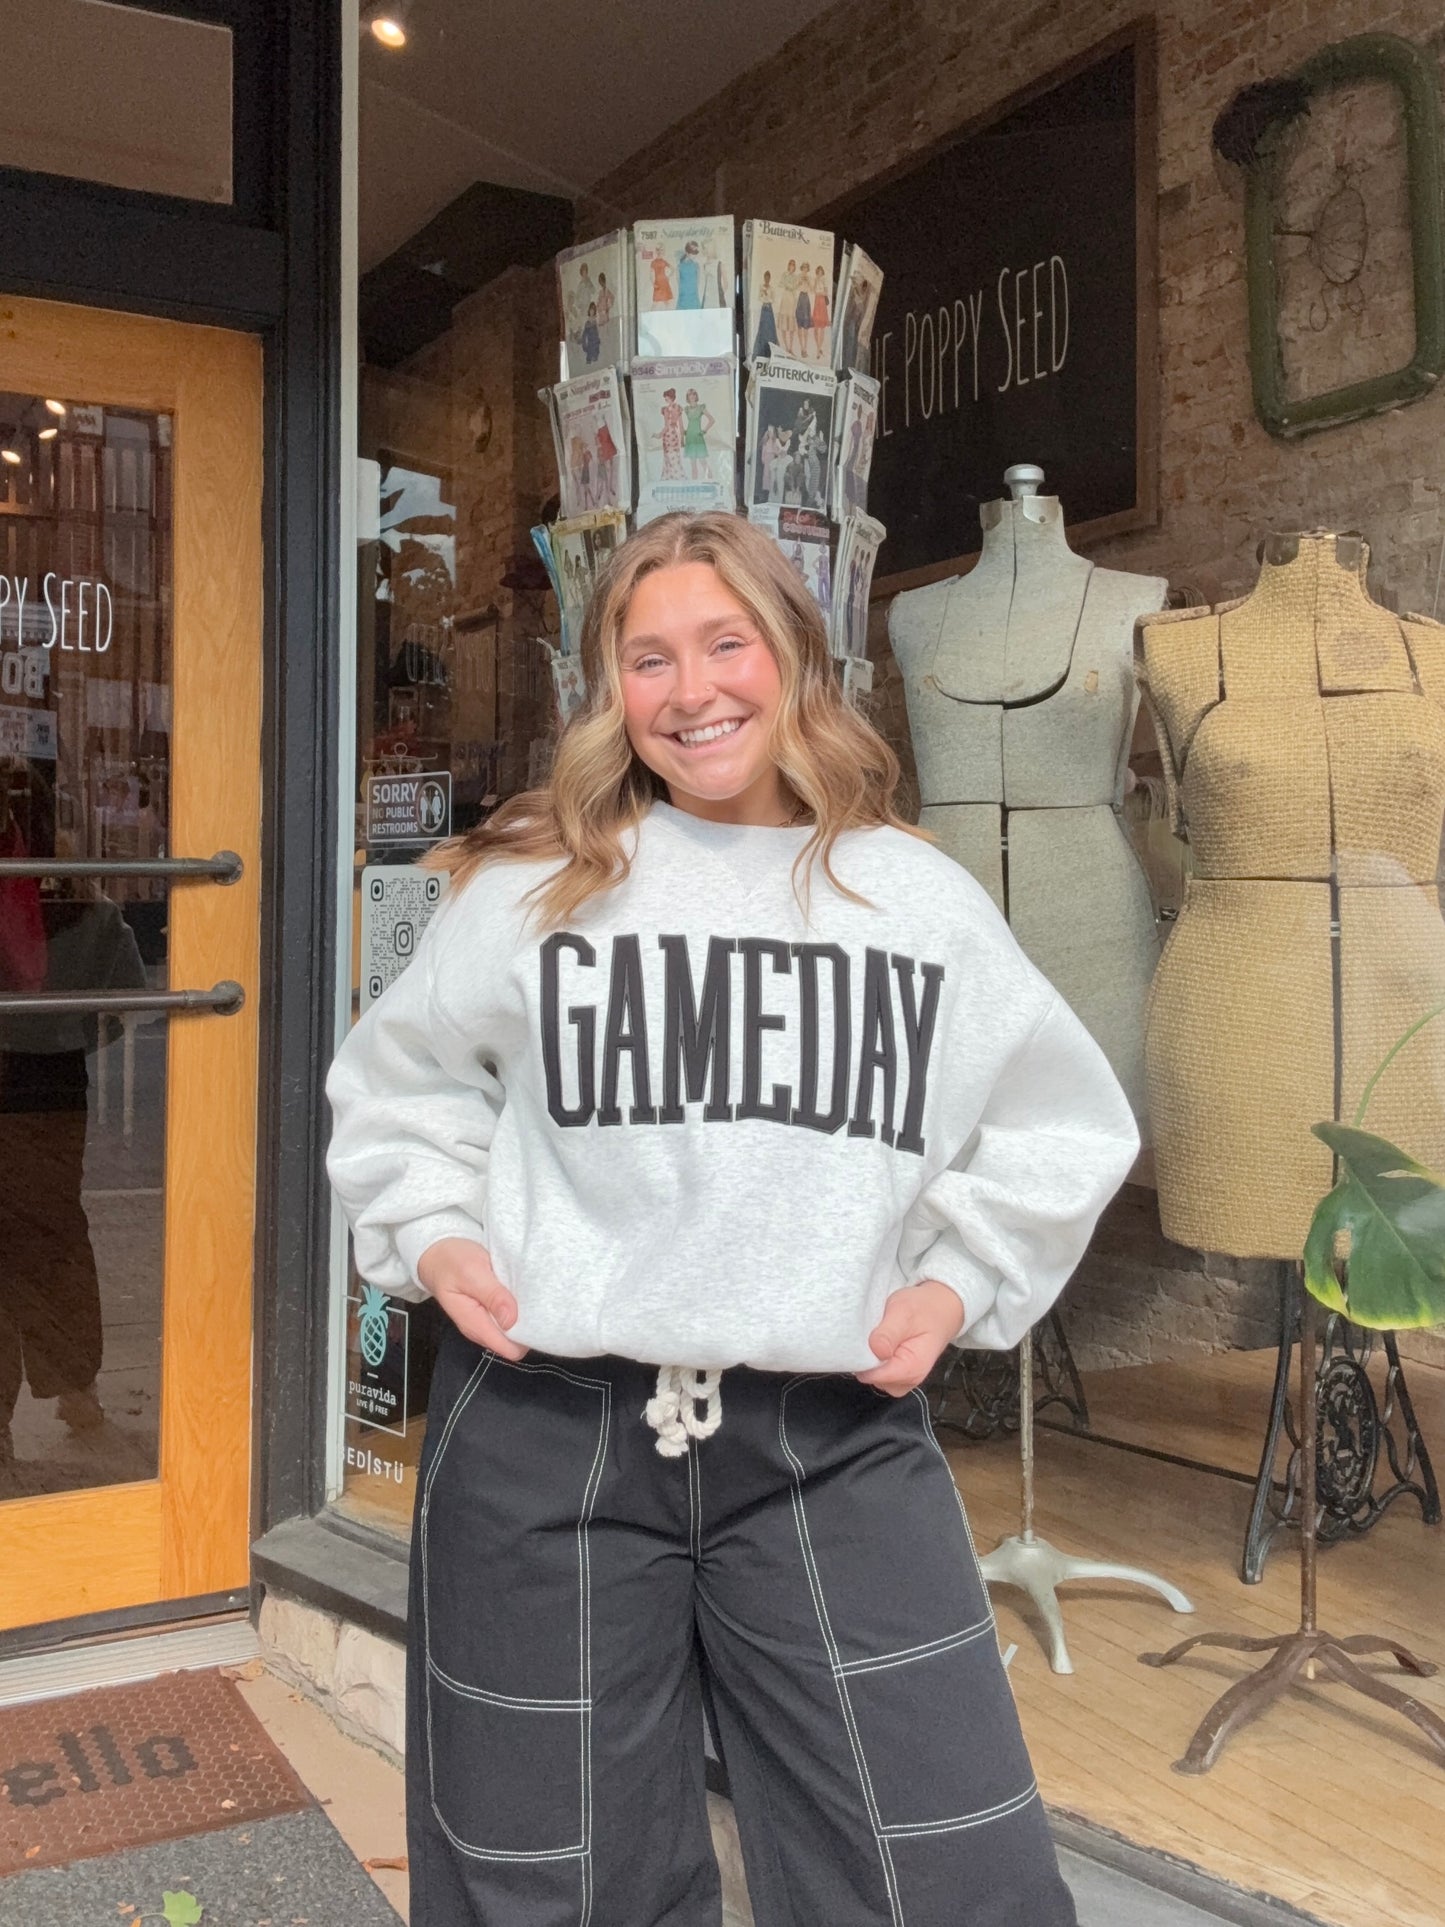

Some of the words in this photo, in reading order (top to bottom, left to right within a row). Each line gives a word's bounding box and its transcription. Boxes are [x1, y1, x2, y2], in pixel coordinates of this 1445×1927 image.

[759, 220, 810, 245] Butterick
[655, 360, 709, 376] Simplicity
[905, 289, 983, 428] POPPY
[372, 782, 419, 804] SORRY
[372, 809, 384, 820] NO
[385, 806, 415, 819] PUBLIC
[372, 821, 418, 834] RESTROOMS
[540, 932, 945, 1156] GAMEDAY
[356, 1398, 368, 1409] LIVE
[375, 1404, 388, 1416] FREE
